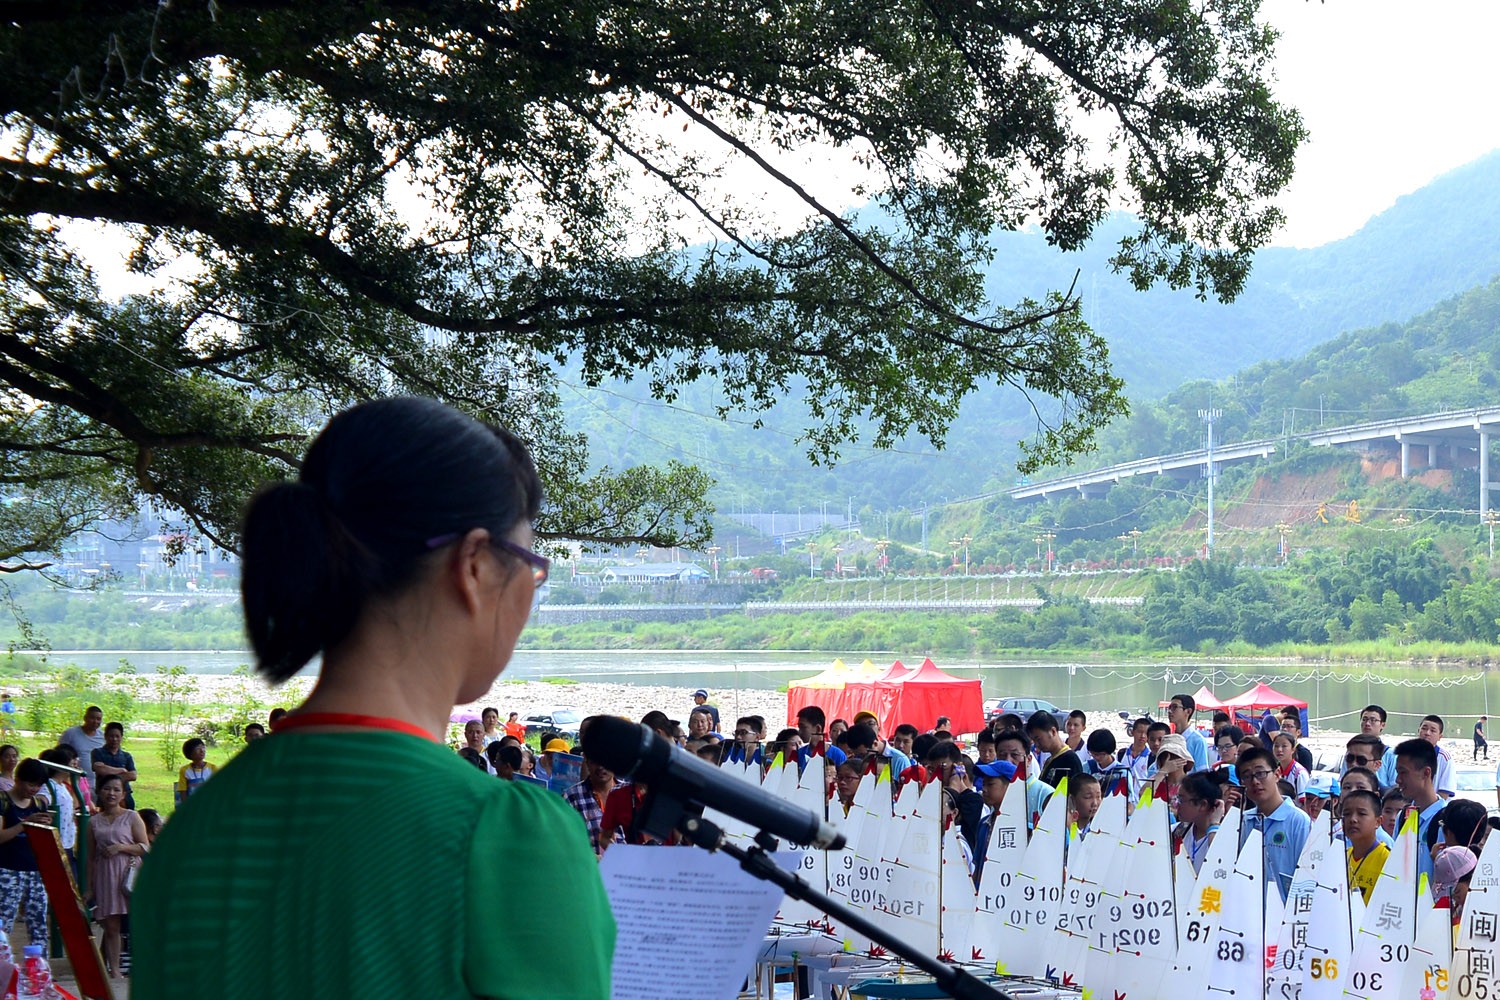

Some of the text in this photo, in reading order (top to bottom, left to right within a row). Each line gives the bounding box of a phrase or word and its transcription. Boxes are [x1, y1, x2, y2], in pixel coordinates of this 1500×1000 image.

[1023, 886, 1060, 902] 910
[1197, 886, 1222, 914] 泉
[1131, 899, 1173, 920] 902
[1187, 920, 1211, 944] 61
[1469, 909, 1498, 942] 闽
[1379, 943, 1410, 963] 30
[1310, 958, 1339, 980] 56
